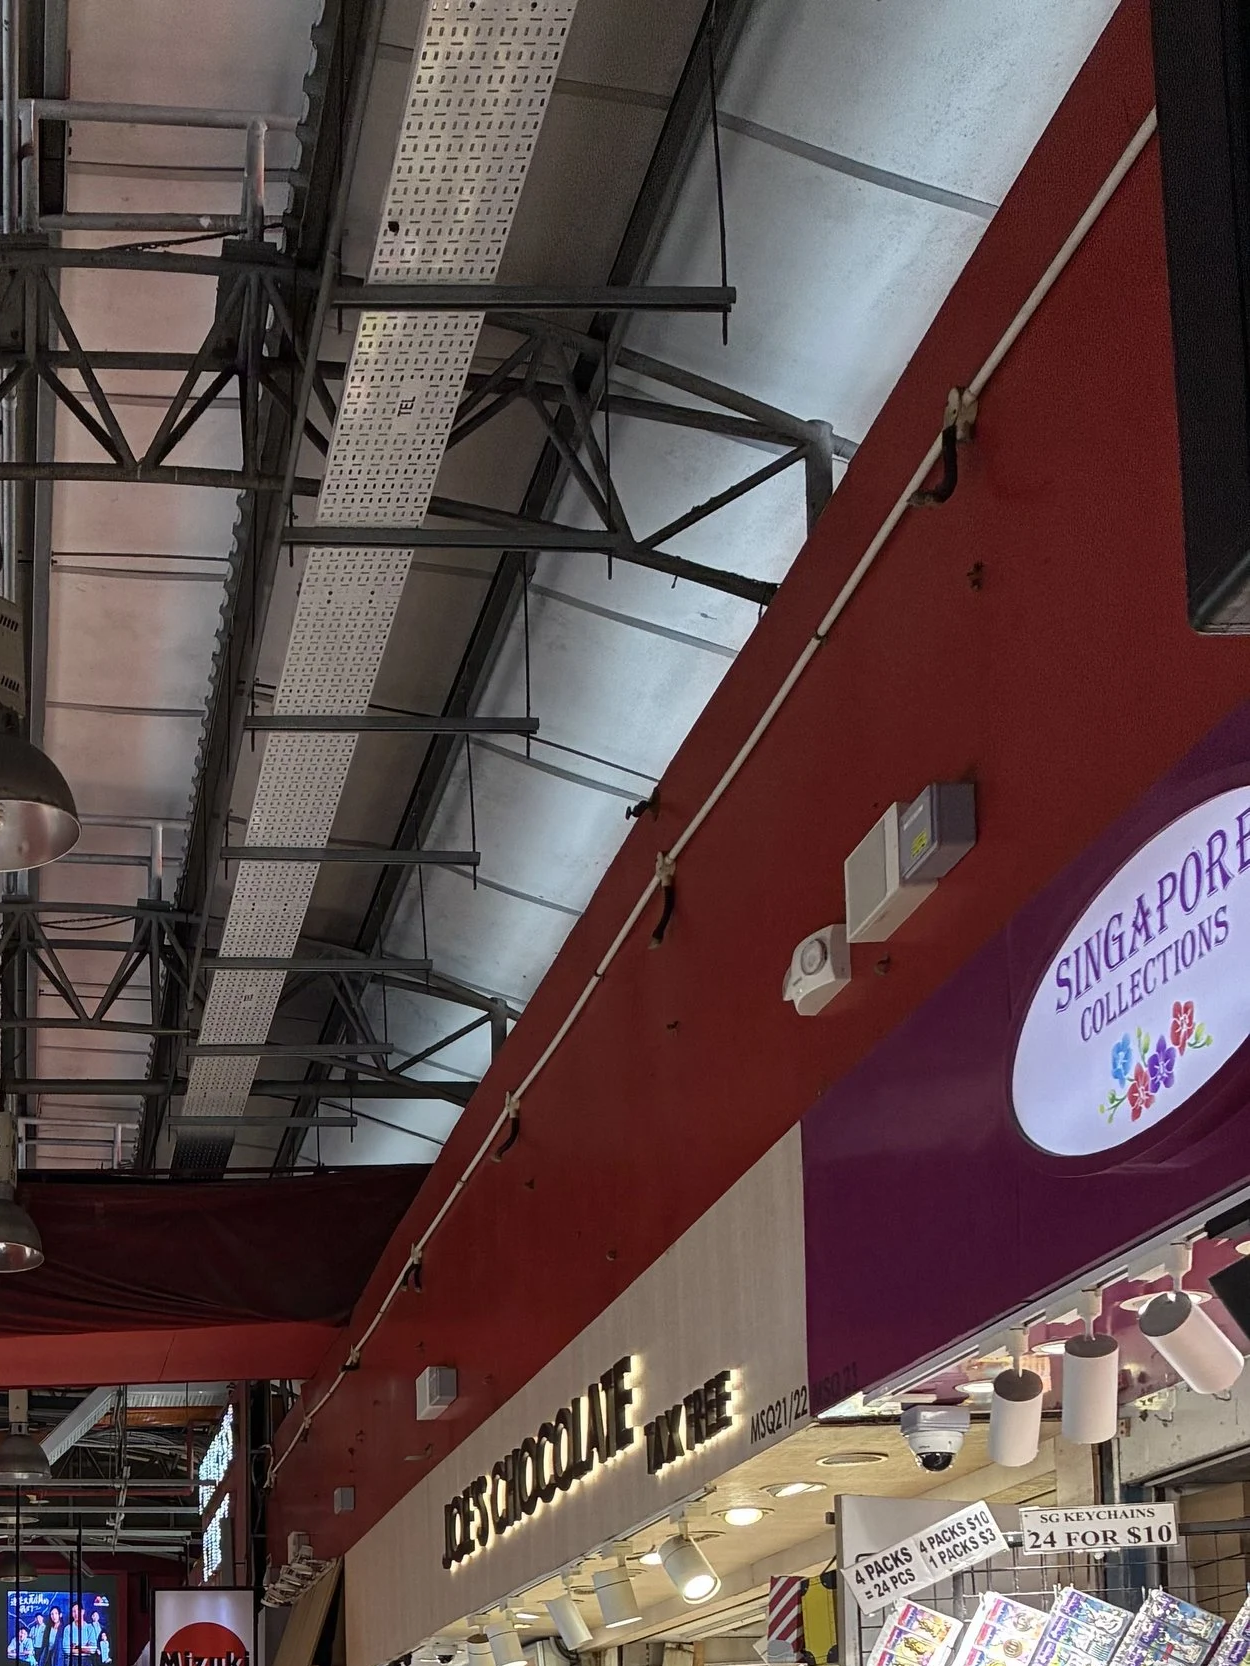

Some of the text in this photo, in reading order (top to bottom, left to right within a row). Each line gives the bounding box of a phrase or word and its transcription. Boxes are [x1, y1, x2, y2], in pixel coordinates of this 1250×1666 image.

[1080, 906, 1230, 1042] COLLECTIONS
[643, 1370, 733, 1475] TAX FREE
[750, 1385, 808, 1445] MSQ21/22
[491, 1355, 635, 1536] CHOCOLATE
[918, 1509, 991, 1555] 4 PACKS $10
[1028, 1523, 1173, 1550] 24 FOR $10
[1039, 1507, 1156, 1524] SG KEYCHAINS
[854, 1546, 914, 1587] 4 PACKS
[928, 1527, 997, 1570] 1 PACKS $3
[874, 1582, 890, 1598] 24
[890, 1568, 916, 1592] PCS
